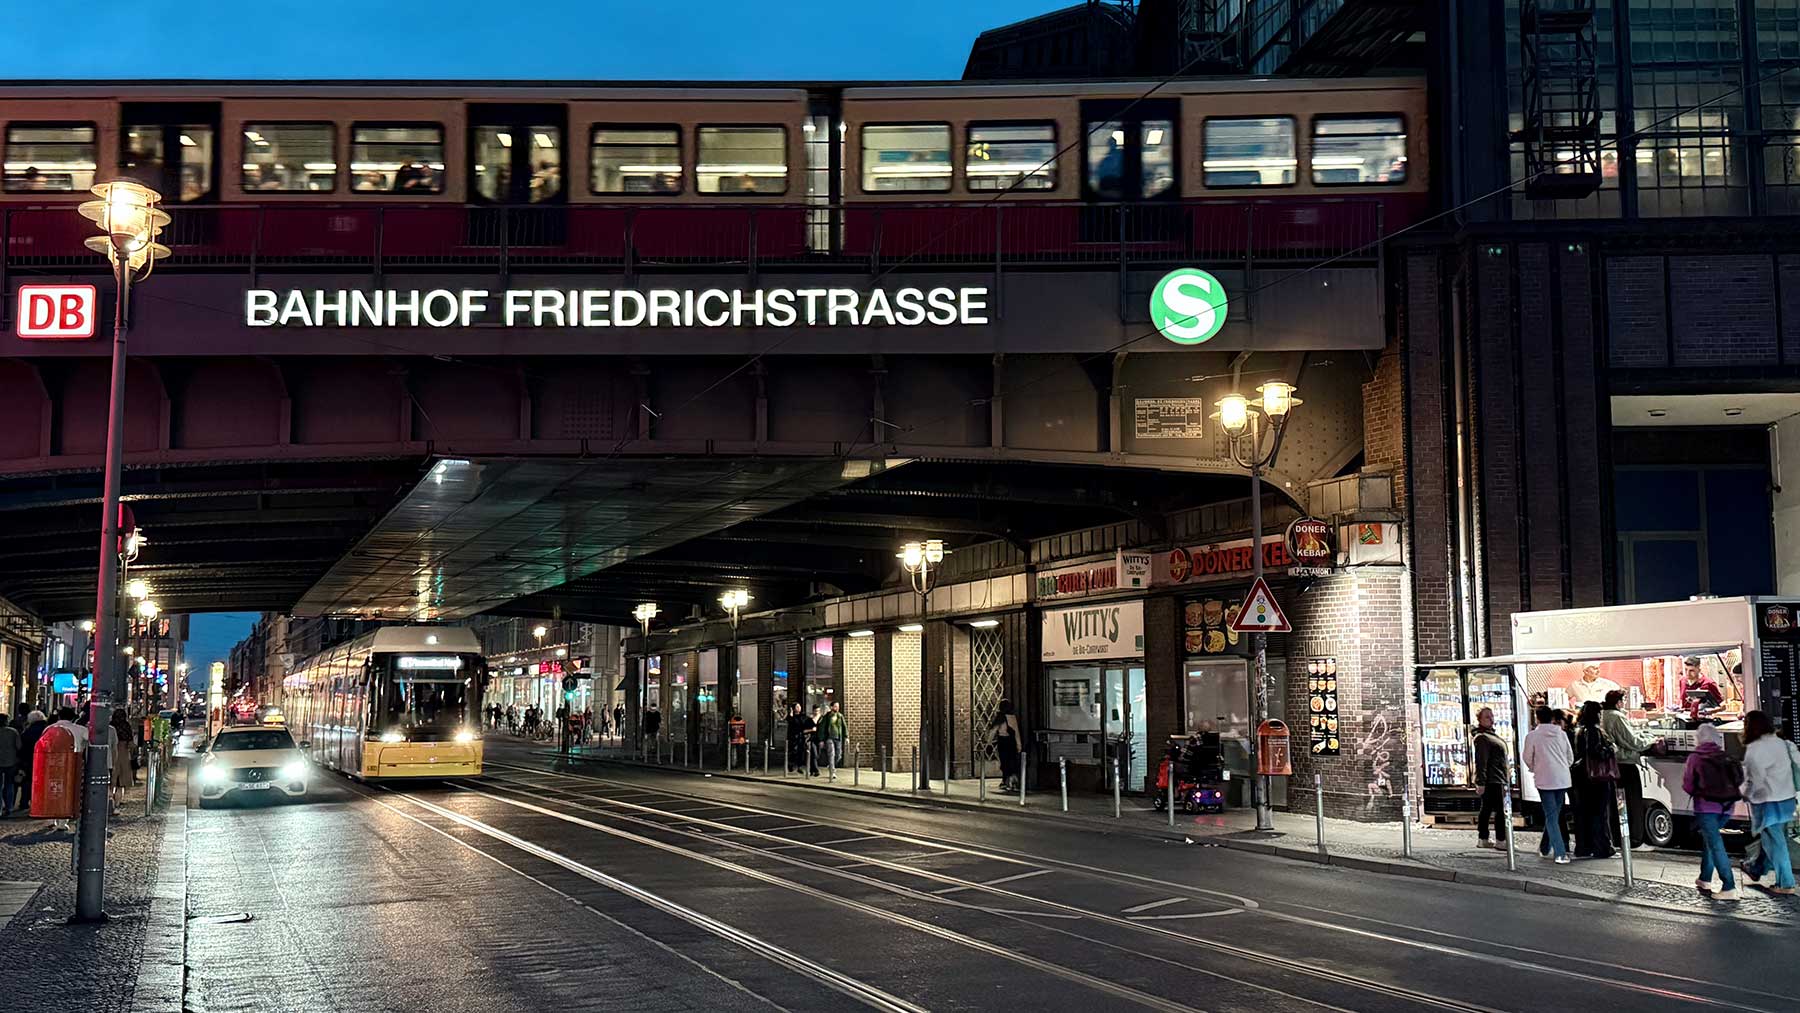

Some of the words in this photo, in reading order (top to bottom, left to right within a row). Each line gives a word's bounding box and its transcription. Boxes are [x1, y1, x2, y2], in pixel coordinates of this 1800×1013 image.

[28, 294, 86, 330] DB
[247, 289, 489, 327] BAHNHOF
[505, 287, 989, 327] FRIEDRICHSTRASSE
[1162, 274, 1216, 339] S
[1297, 549, 1327, 557] KEBAP
[1063, 607, 1120, 646] WITTY'S
